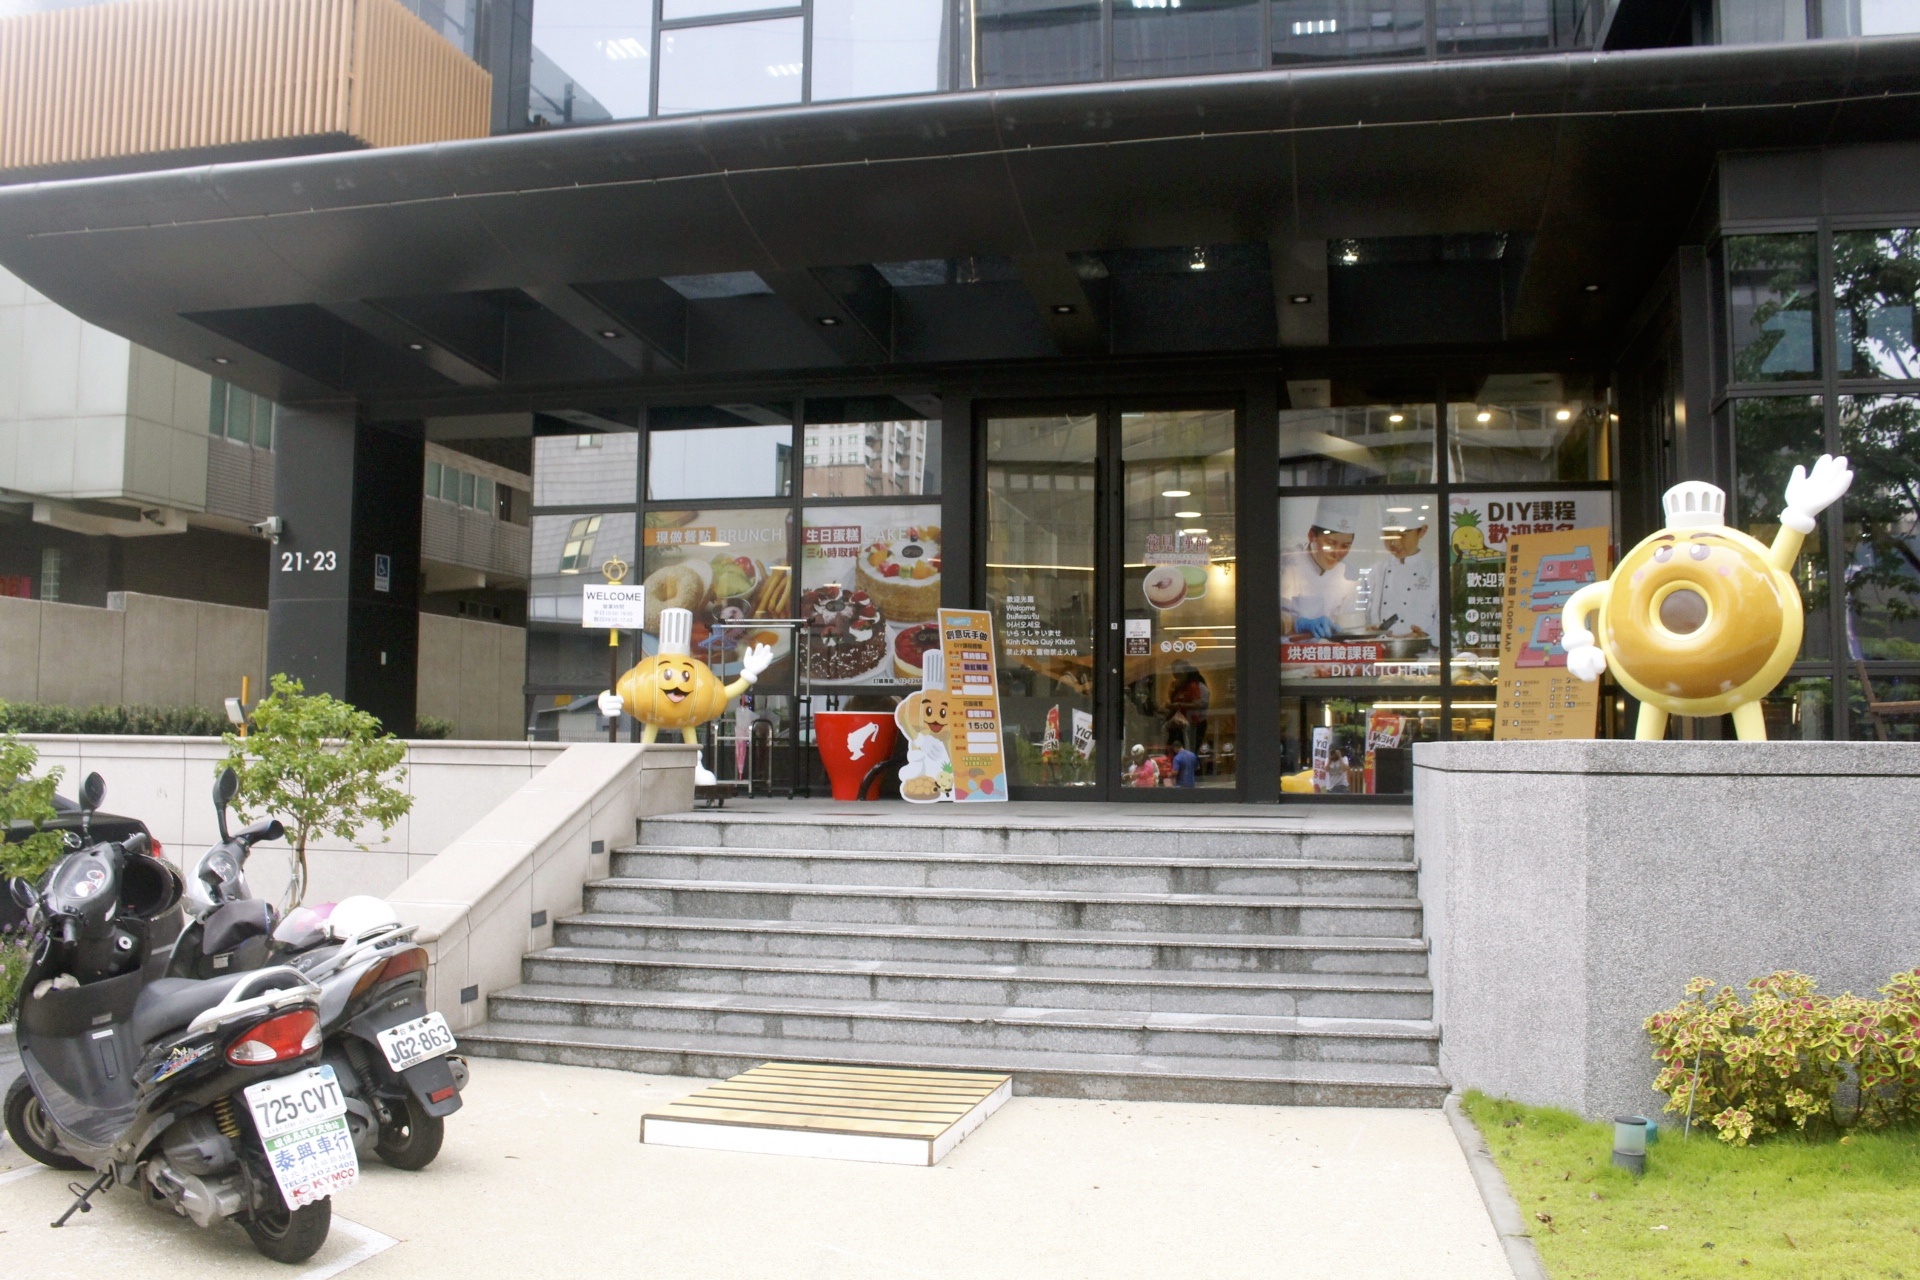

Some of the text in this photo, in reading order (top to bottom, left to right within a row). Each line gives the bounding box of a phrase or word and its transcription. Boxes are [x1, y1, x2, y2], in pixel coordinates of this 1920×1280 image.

[1488, 500, 1576, 521] DIY課程
[655, 528, 782, 544] 現做餐點 BRUNCH
[806, 529, 860, 543] 生日蛋糕
[586, 591, 642, 602] WELCOME
[1006, 621, 1041, 629] 어서오세요
[1287, 645, 1377, 661] 烘焙體驗課程
[1331, 664, 1428, 677] DIY KITCHEN
[275, 1131, 349, 1172] 泰興車行
[312, 1168, 355, 1189] KYMCO
